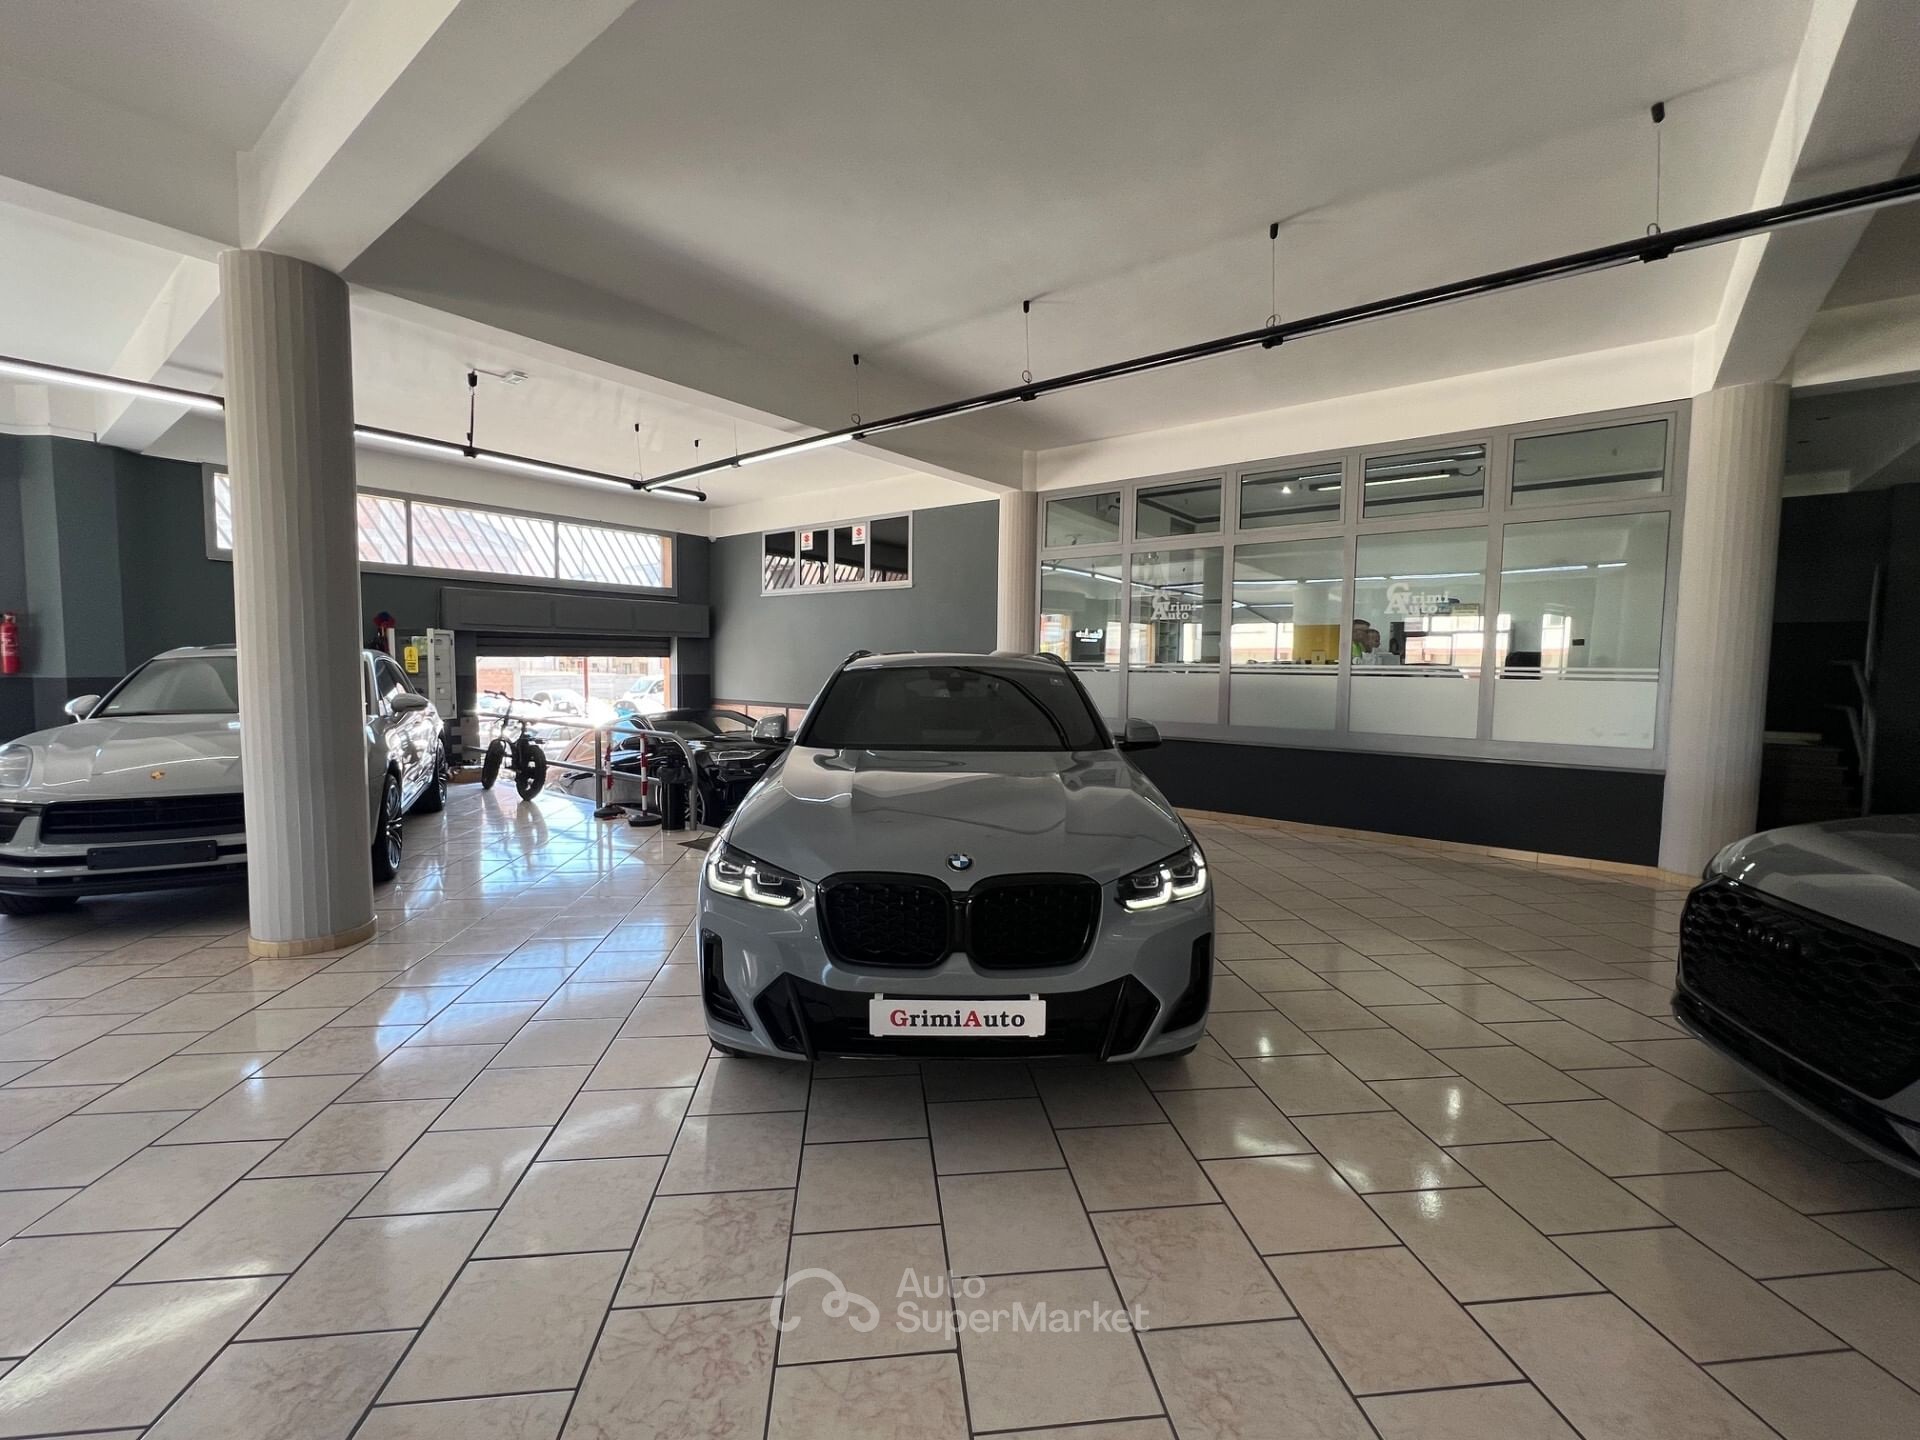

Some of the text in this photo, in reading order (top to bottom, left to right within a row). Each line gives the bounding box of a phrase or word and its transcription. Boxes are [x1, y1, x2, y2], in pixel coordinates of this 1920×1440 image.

[1383, 593, 1438, 615] Auto
[1386, 582, 1449, 611] Grimi
[1150, 603, 1189, 620] Auto
[889, 1009, 1026, 1028] GrimiAuto
